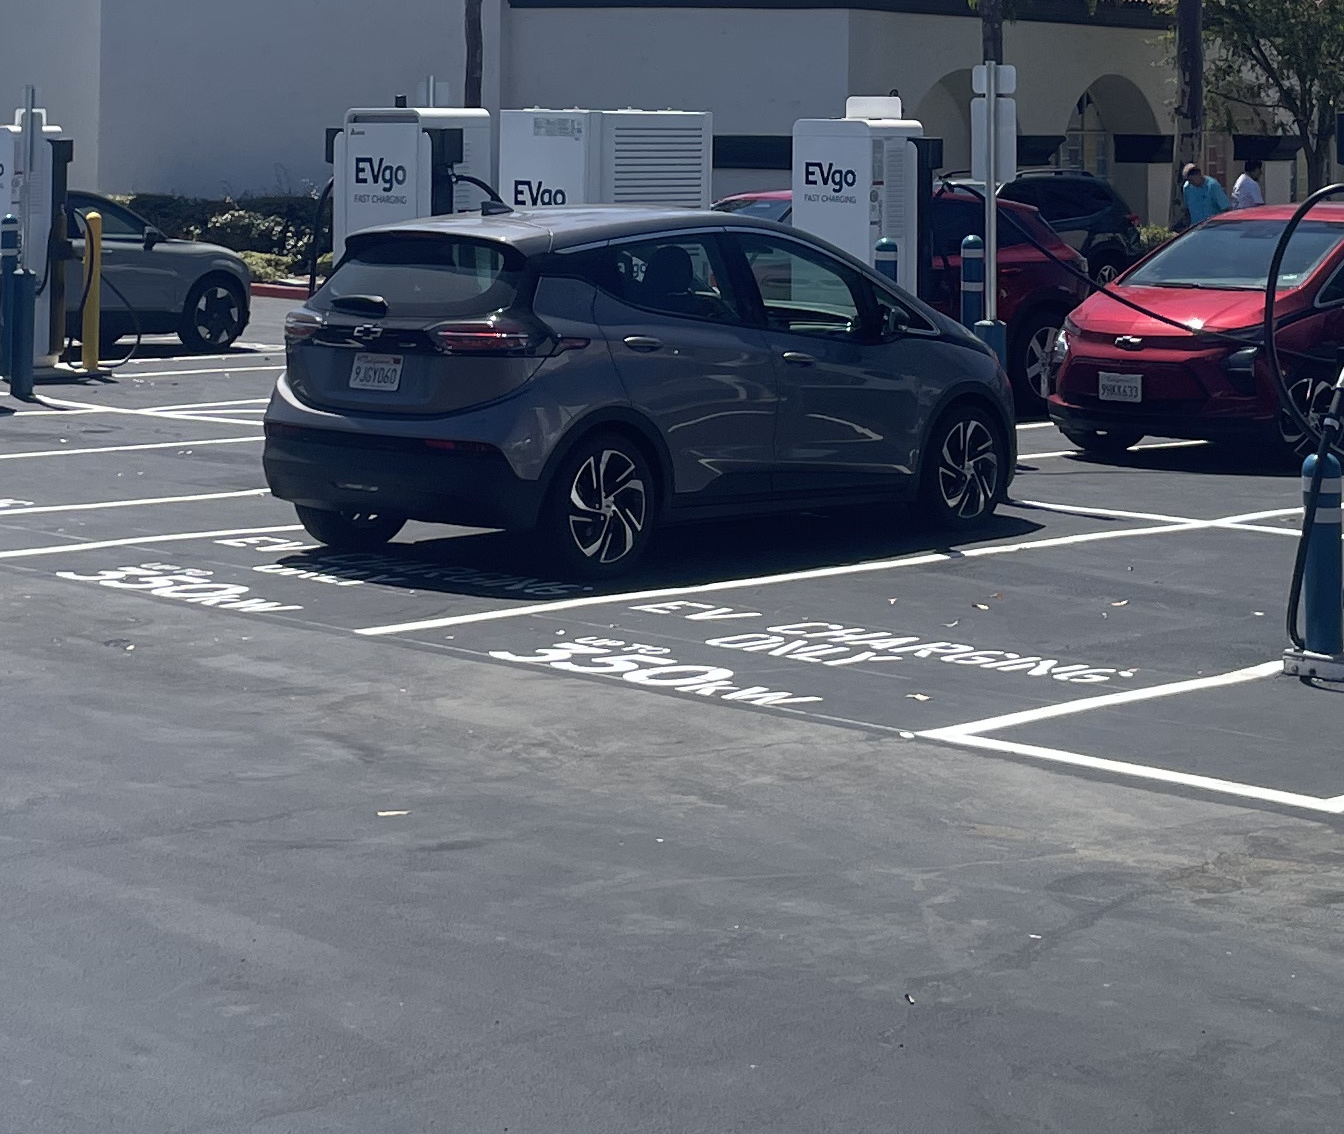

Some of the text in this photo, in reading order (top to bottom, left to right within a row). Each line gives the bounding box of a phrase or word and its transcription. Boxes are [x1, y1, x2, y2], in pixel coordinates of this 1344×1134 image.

[355, 157, 407, 193] EVgo
[804, 161, 857, 193] EVgo
[354, 194, 408, 205] FAST CHARGING
[804, 193, 857, 204] FAST CHARGING
[213, 536, 328, 553] EV
[55, 565, 304, 613] 350kW
[573, 636, 672, 655] UP TO
[627, 600, 1117, 684] EV CHARGING
[704, 633, 904, 667] ONLY
[487, 641, 824, 706] 350kW
